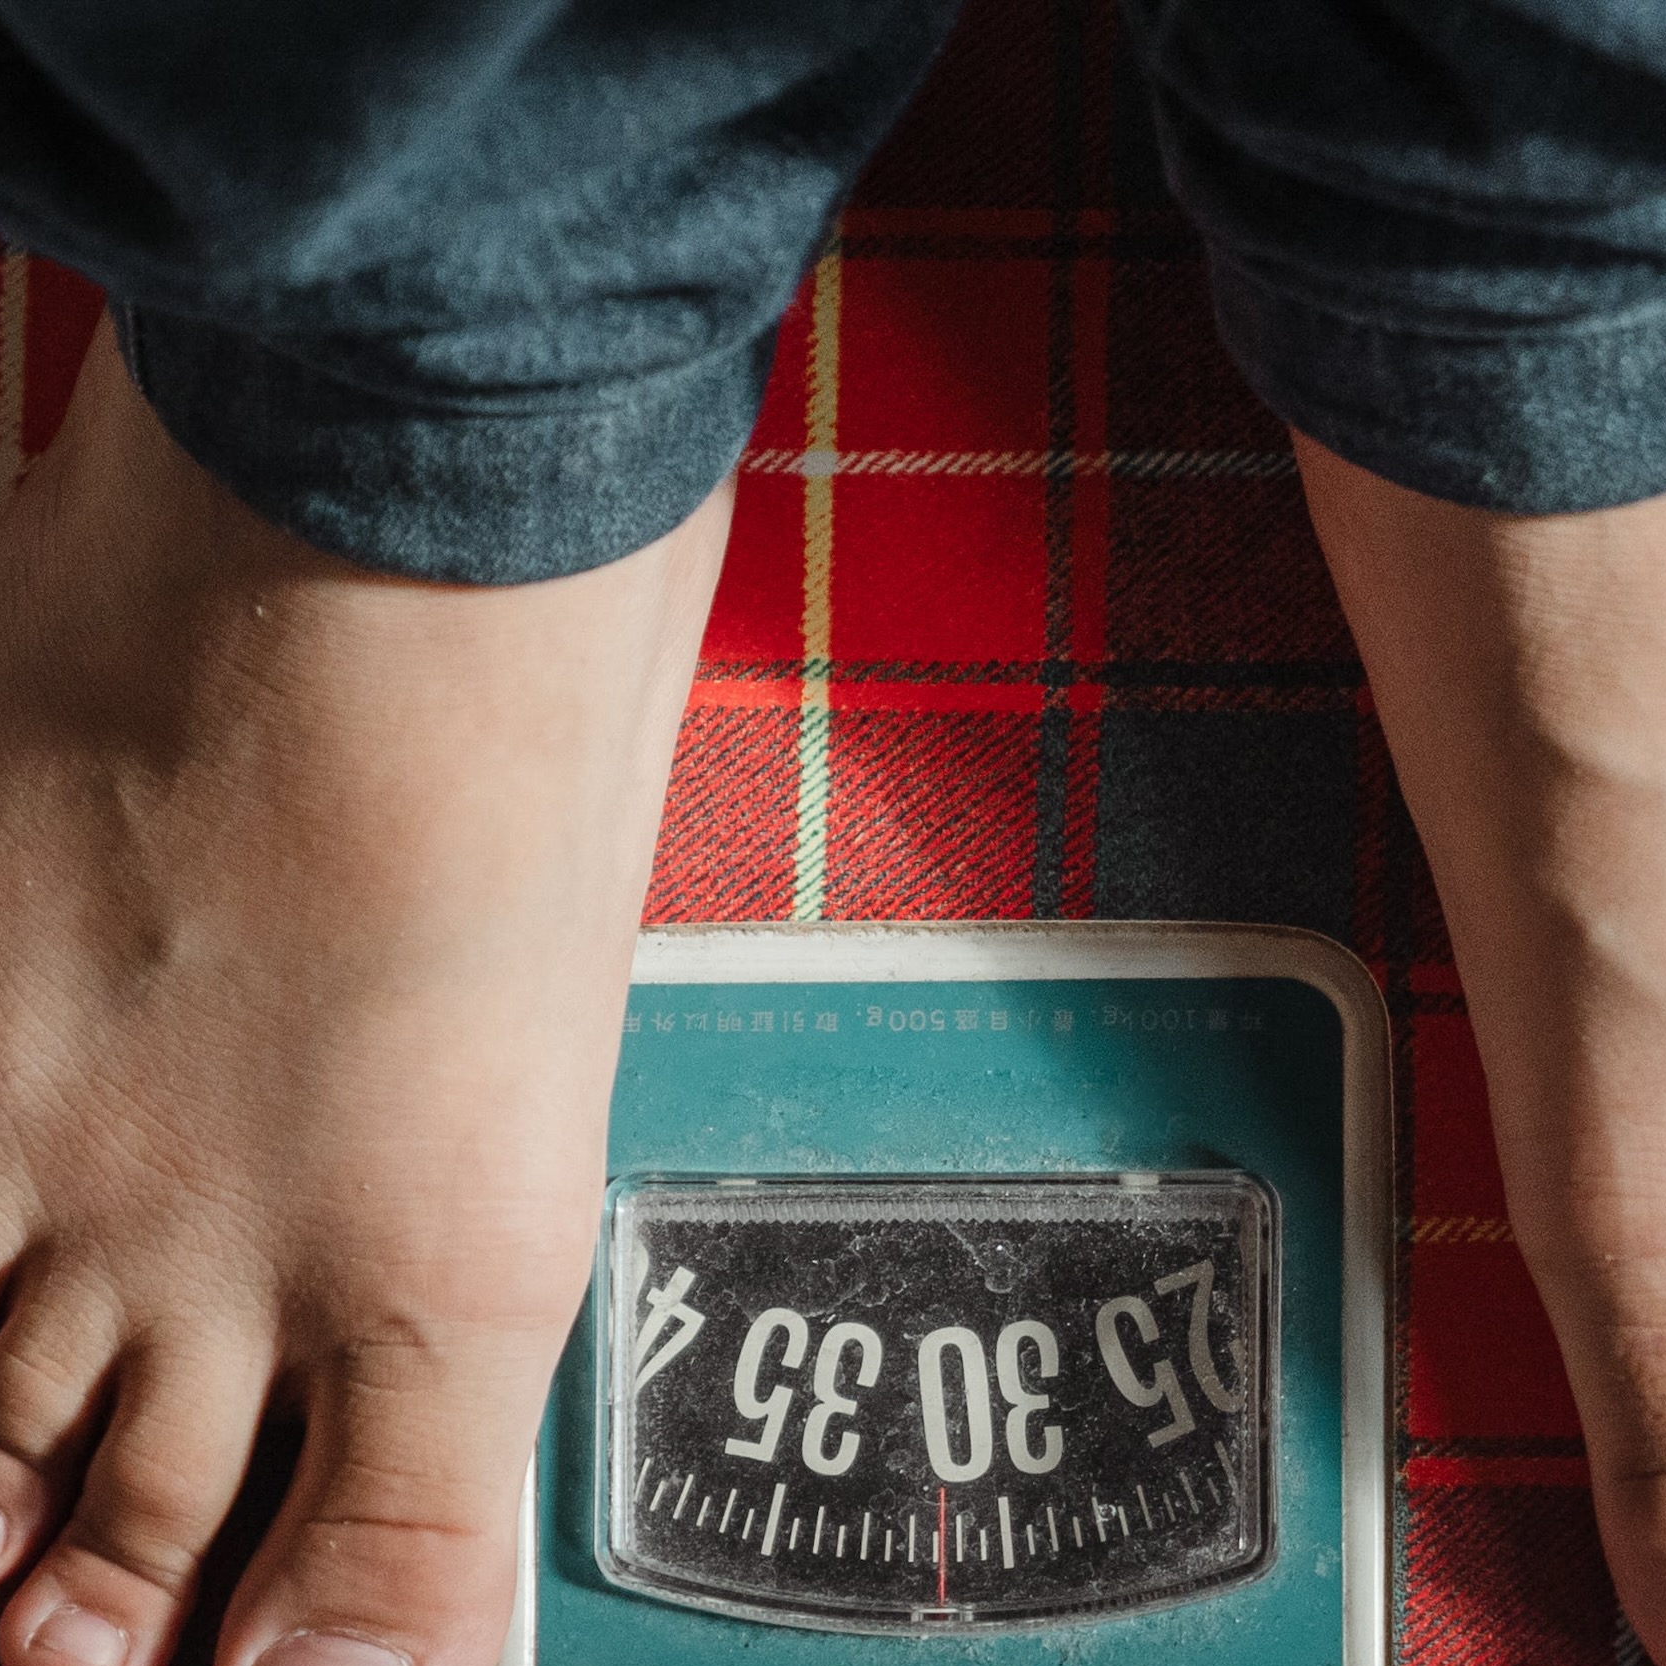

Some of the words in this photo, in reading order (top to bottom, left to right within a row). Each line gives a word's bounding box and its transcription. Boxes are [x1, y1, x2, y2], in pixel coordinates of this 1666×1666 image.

[635, 1241, 706, 1394] 4
[725, 1307, 882, 1476] 35
[1096, 1259, 1244, 1447] 25
[918, 1320, 1064, 1482] 30
